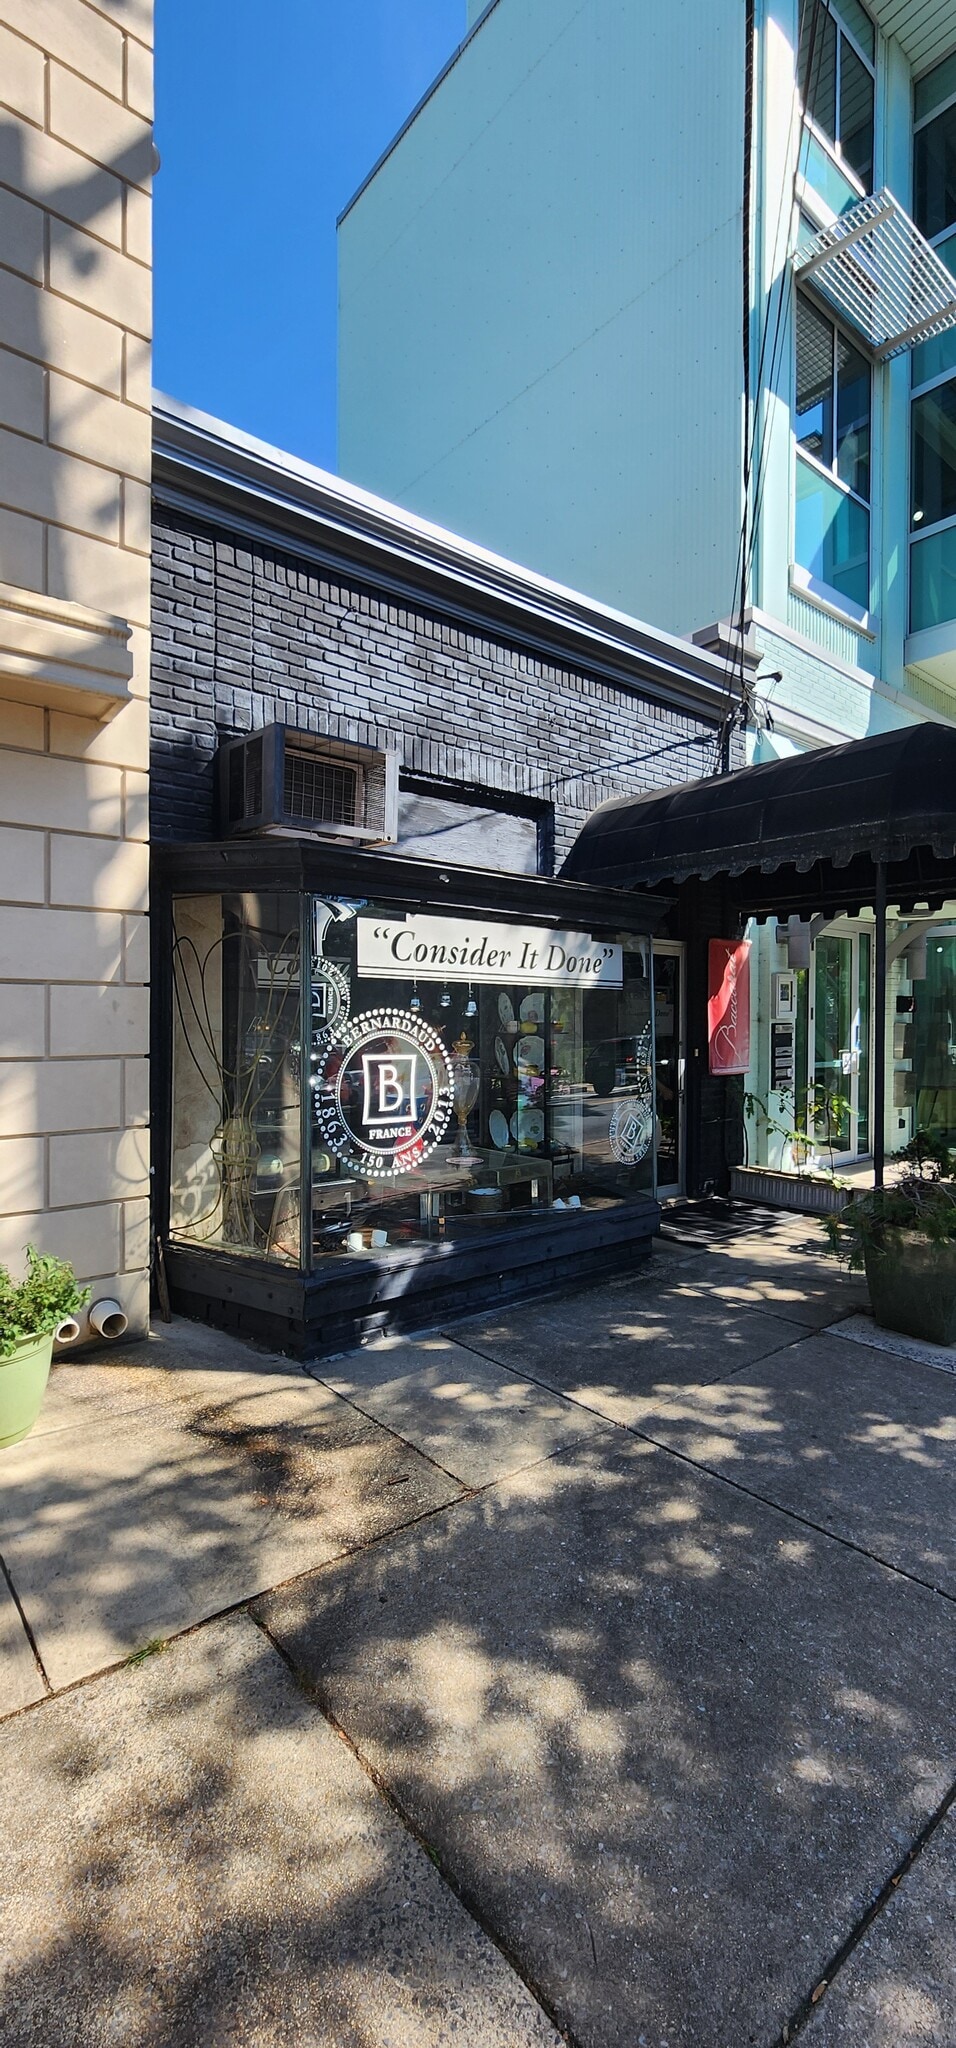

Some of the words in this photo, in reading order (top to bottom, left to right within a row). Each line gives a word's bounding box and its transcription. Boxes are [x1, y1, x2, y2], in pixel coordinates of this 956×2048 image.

[373, 927, 511, 968] “Consider
[518, 942, 539, 970] It
[544, 944, 613, 974] Done”
[715, 948, 742, 1064] Baccarat
[342, 1016, 436, 1052] BERNARDAUD
[378, 1064, 403, 1112] B
[321, 1092, 348, 1147] 1863
[360, 1153, 383, 1169] 150
[391, 1147, 421, 1169] ANS
[428, 1087, 450, 1137] 2013
[369, 1126, 412, 1140] FRANCE
